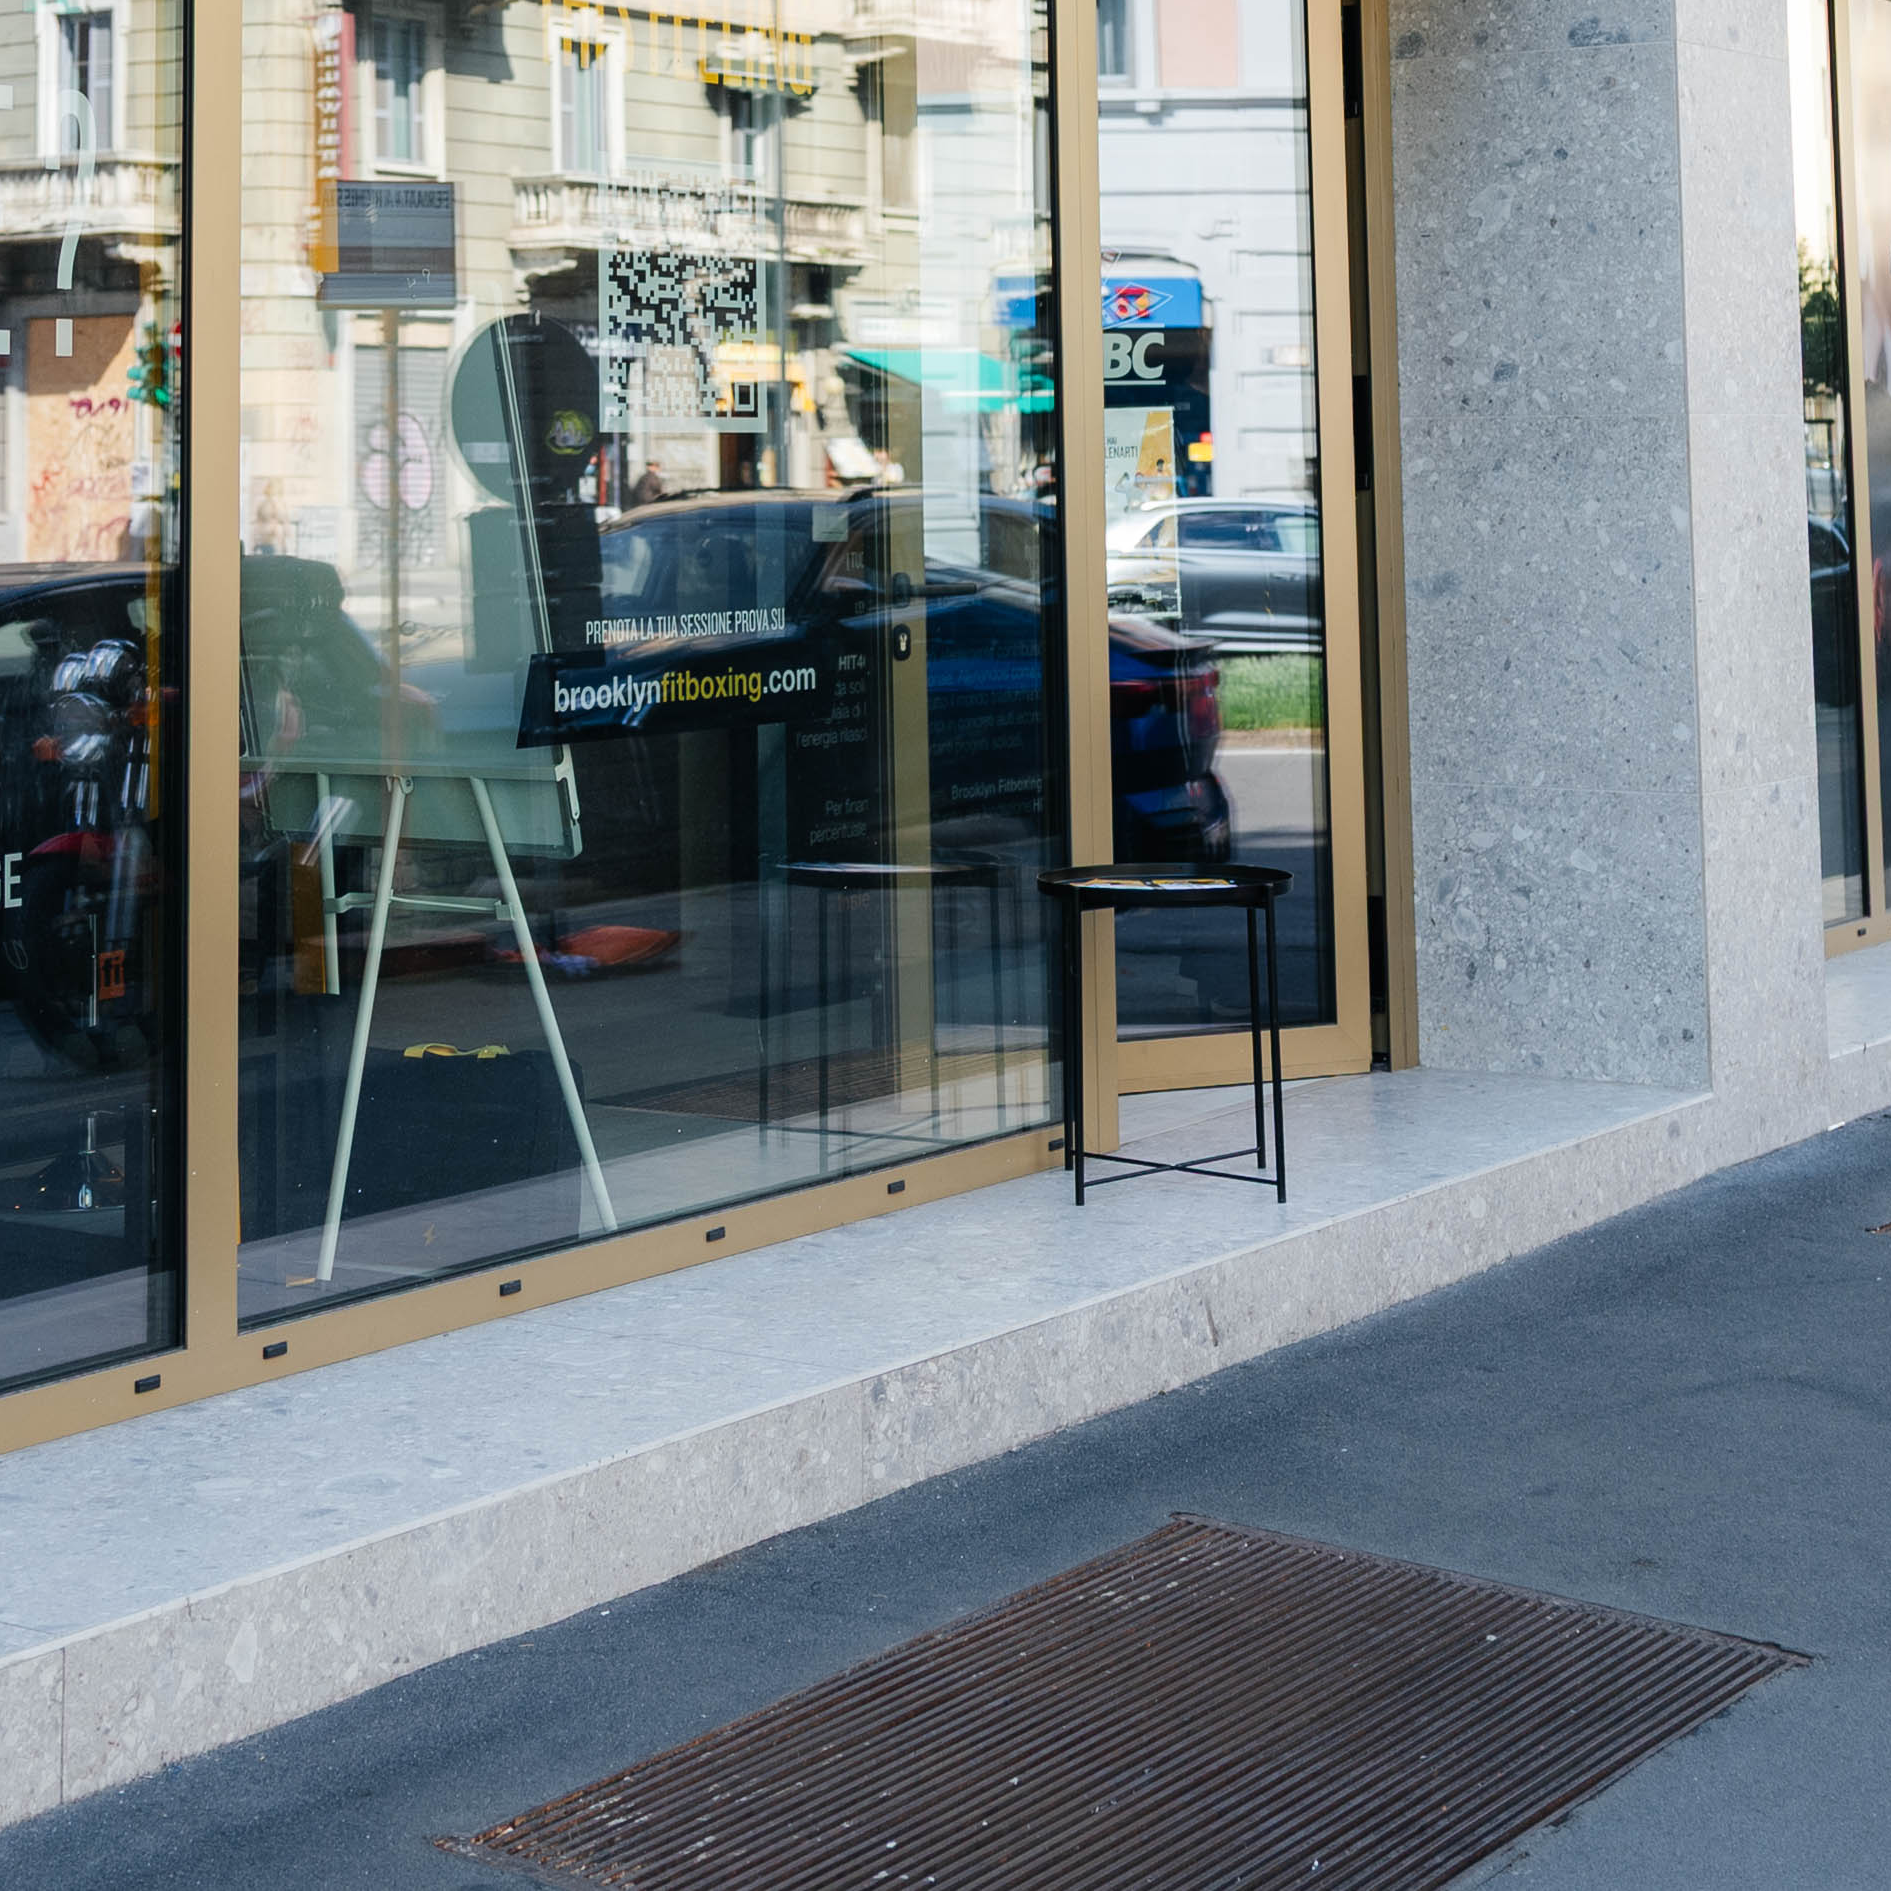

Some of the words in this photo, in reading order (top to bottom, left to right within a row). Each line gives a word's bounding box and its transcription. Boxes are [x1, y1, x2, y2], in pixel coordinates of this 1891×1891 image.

[585, 618, 638, 645] PRENOTA
[640, 617, 654, 641] LA
[656, 615, 678, 639] TUA
[680, 611, 733, 638] SESSIONE
[735, 608, 769, 634] PROVA
[770, 607, 786, 631] SU
[554, 667, 817, 713] brooklynfitboxing.com
